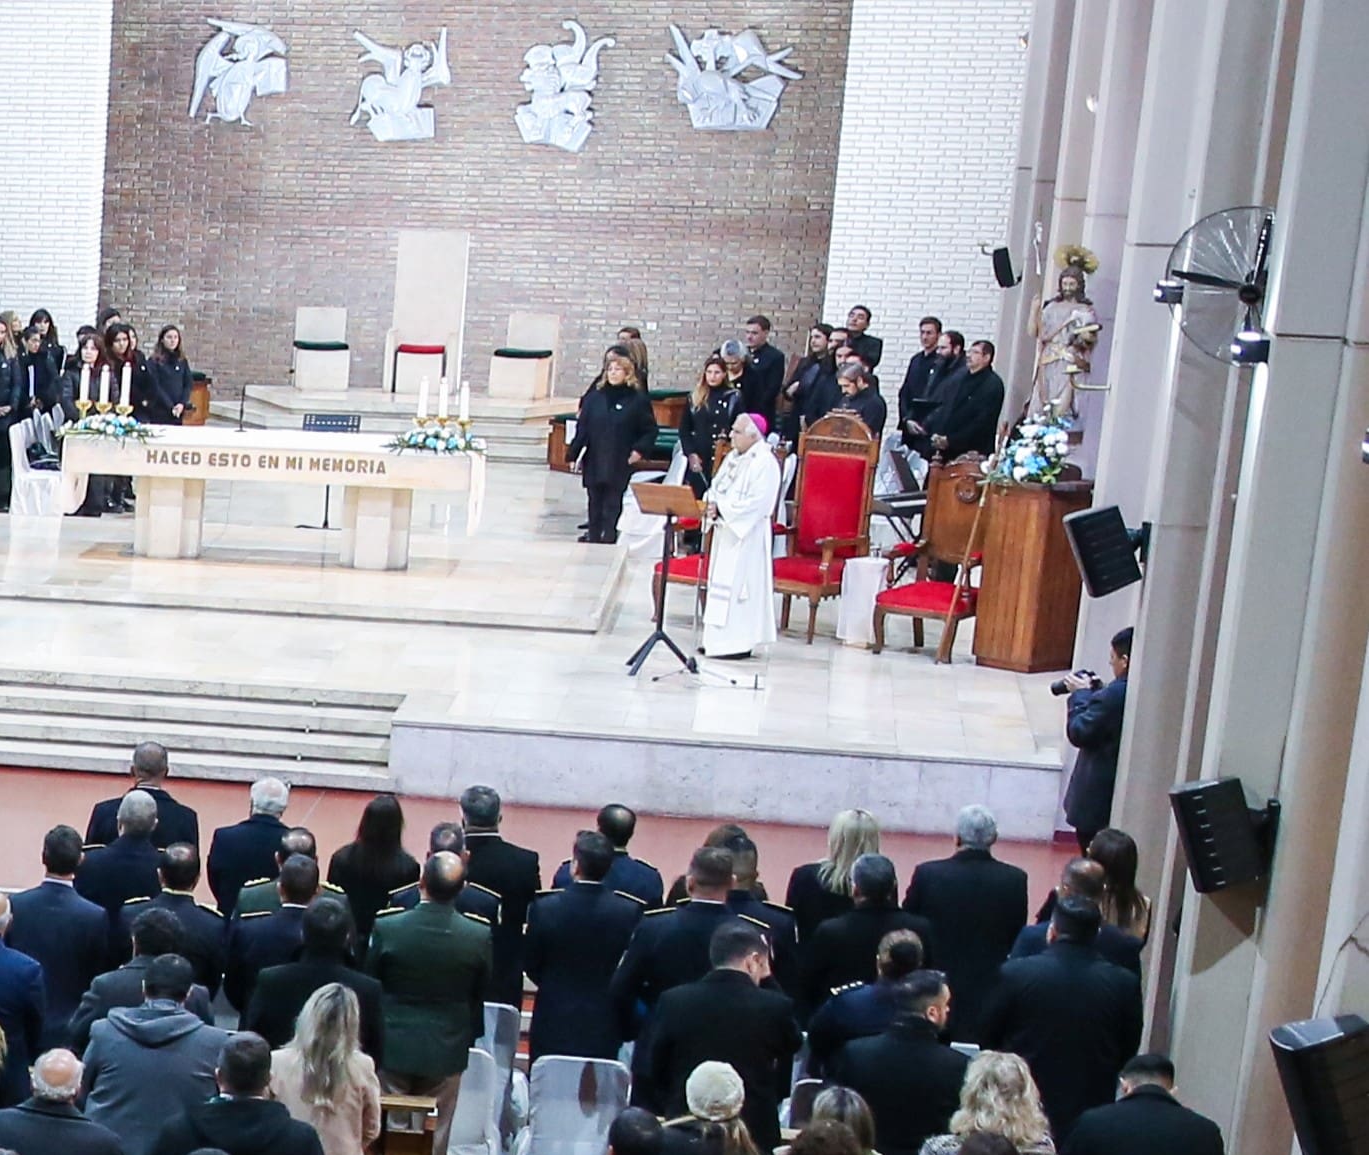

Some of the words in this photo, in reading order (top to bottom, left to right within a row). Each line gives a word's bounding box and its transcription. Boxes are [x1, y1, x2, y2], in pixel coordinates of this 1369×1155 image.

[146, 449, 202, 465] HACED
[208, 452, 251, 468] ESTO
[258, 455, 279, 469] EN
[285, 456, 303, 470] MI
[309, 457, 386, 475] MEMORIA
